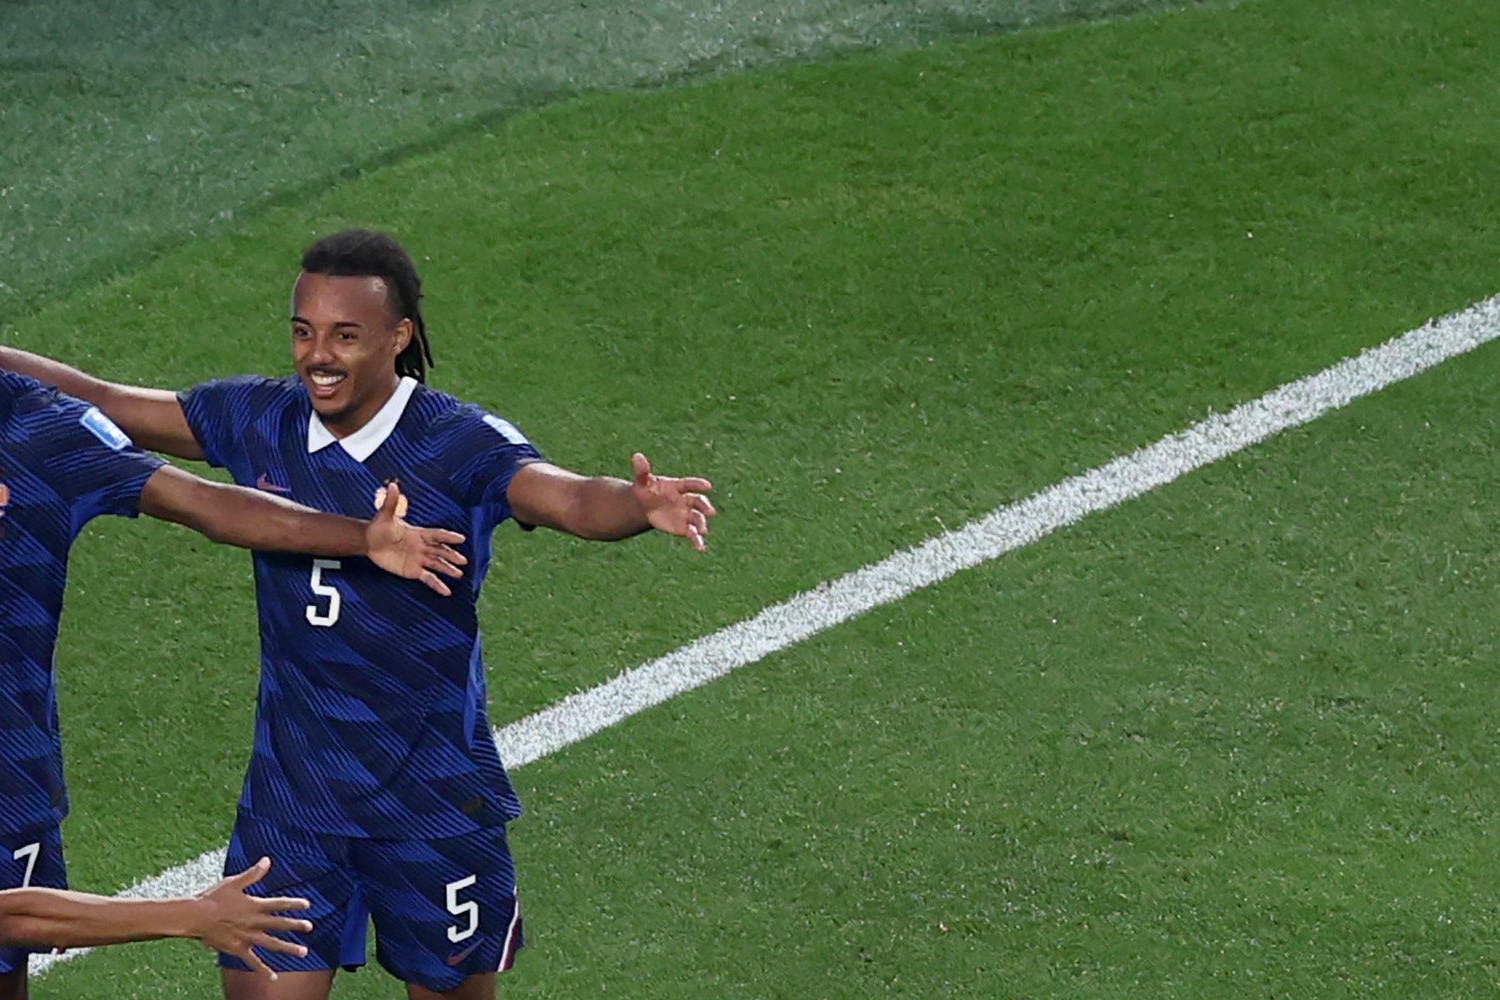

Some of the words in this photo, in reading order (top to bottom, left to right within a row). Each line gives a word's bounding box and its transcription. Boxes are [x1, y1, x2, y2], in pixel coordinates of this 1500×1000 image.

[305, 559, 342, 627] 5
[13, 842, 40, 888] 7
[446, 874, 479, 943] 5
